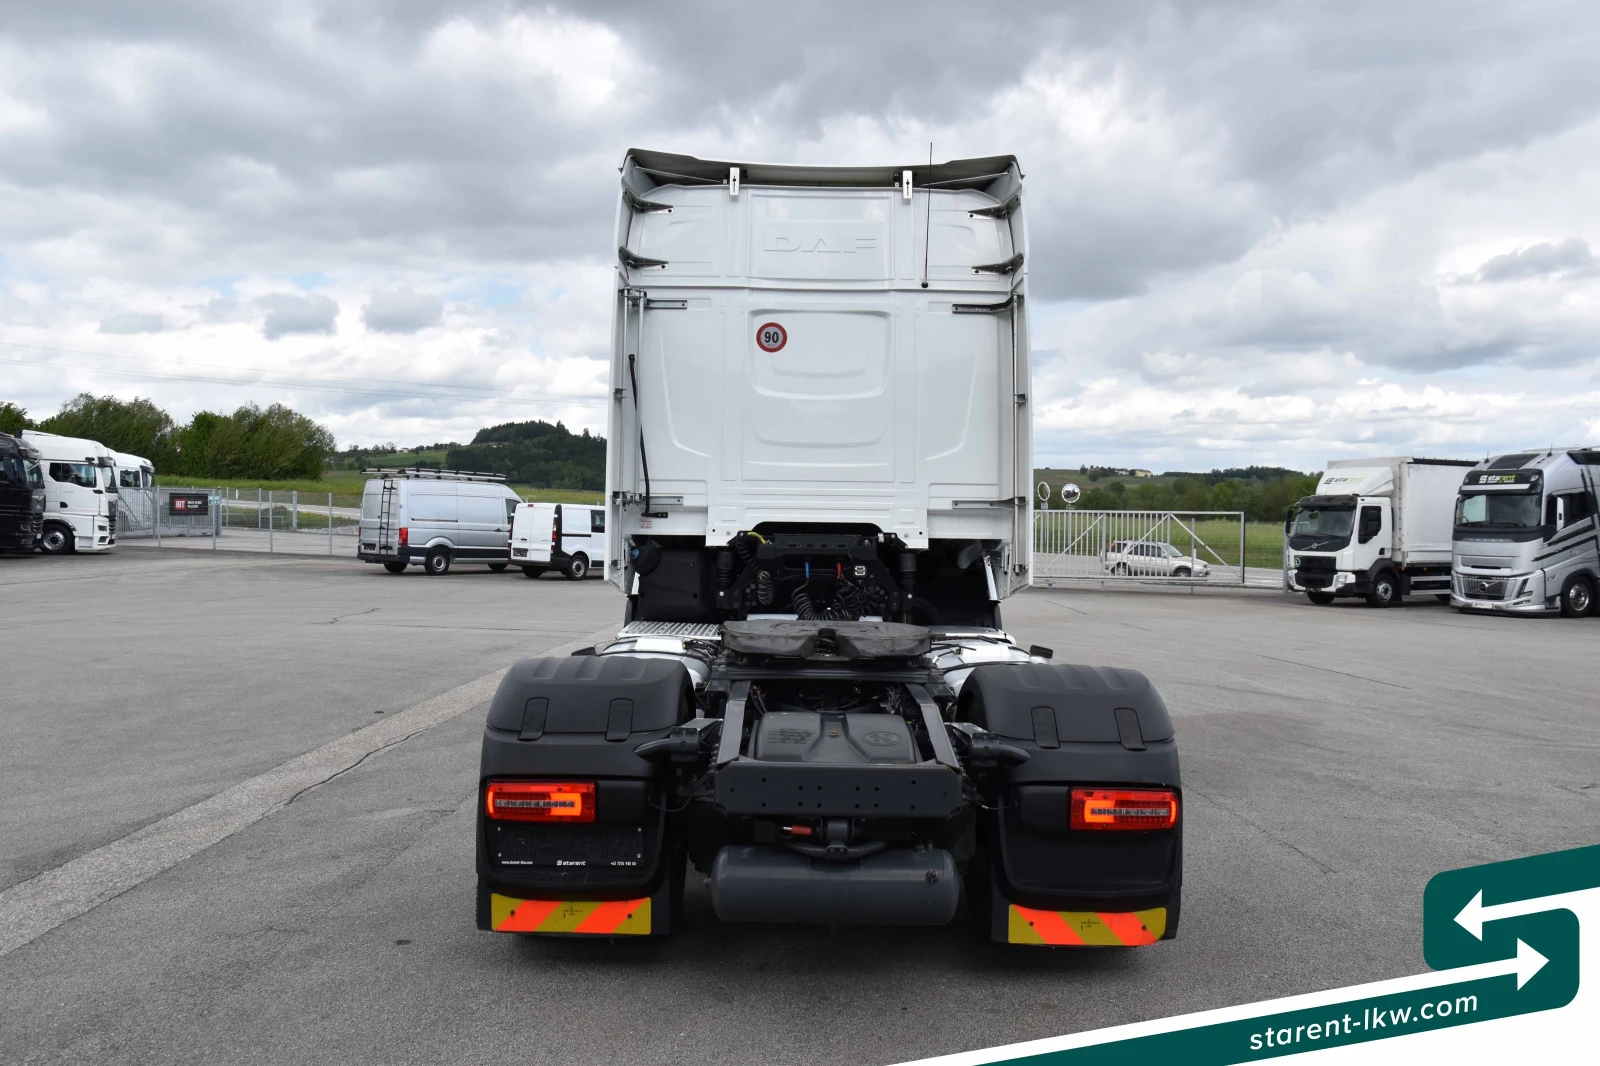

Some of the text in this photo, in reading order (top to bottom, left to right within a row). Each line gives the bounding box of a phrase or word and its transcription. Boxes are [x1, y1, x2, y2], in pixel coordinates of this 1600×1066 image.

[764, 232, 876, 253] DAF
[764, 331, 779, 344] 90
[176, 500, 186, 508] BIT
